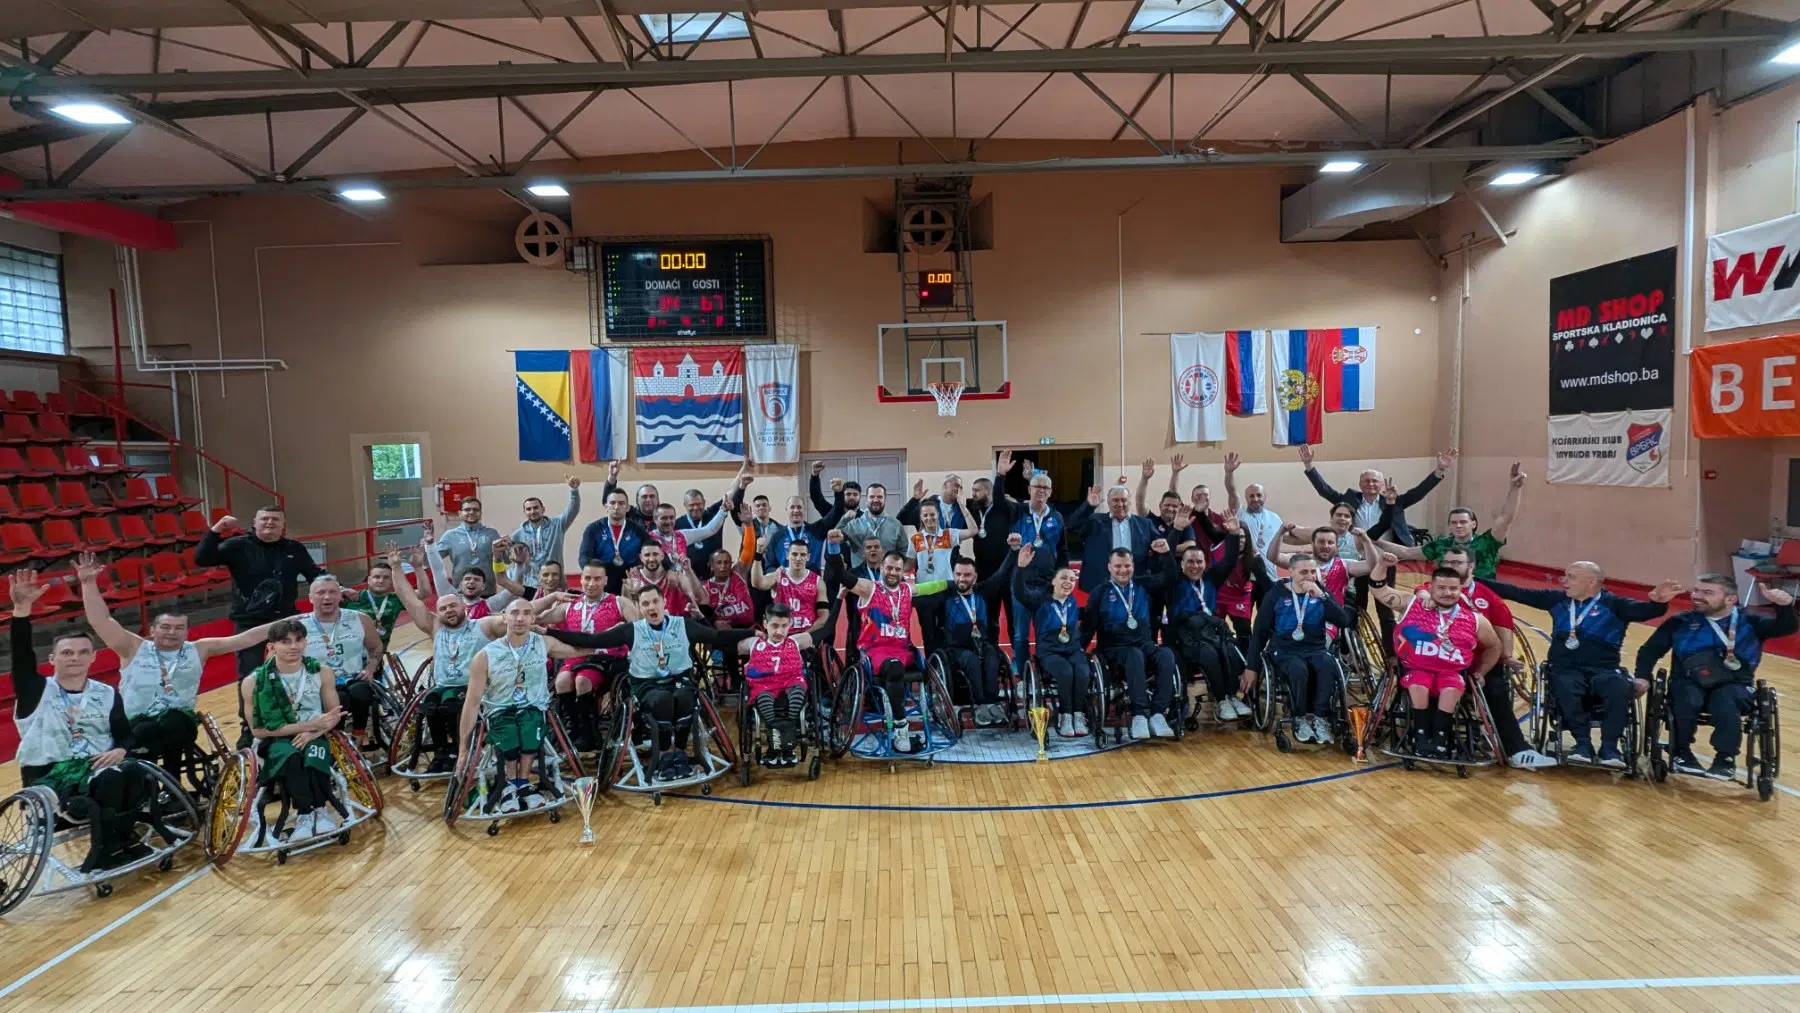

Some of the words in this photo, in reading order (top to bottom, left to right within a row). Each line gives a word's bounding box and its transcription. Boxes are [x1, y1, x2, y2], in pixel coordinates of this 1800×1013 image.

[645, 278, 681, 290] DOMAĆI
[692, 279, 720, 289] GOSTI
[928, 273, 951, 283] 0.00
[1557, 304, 1591, 331] MD
[1600, 289, 1664, 323] SHOP
[1552, 325, 1600, 341] SPORTSKA
[1602, 313, 1667, 333] KLADIONICA
[1560, 367, 1659, 389] www.mdshop.ba
[771, 655, 781, 672] 7
[308, 745, 326, 760] 30
